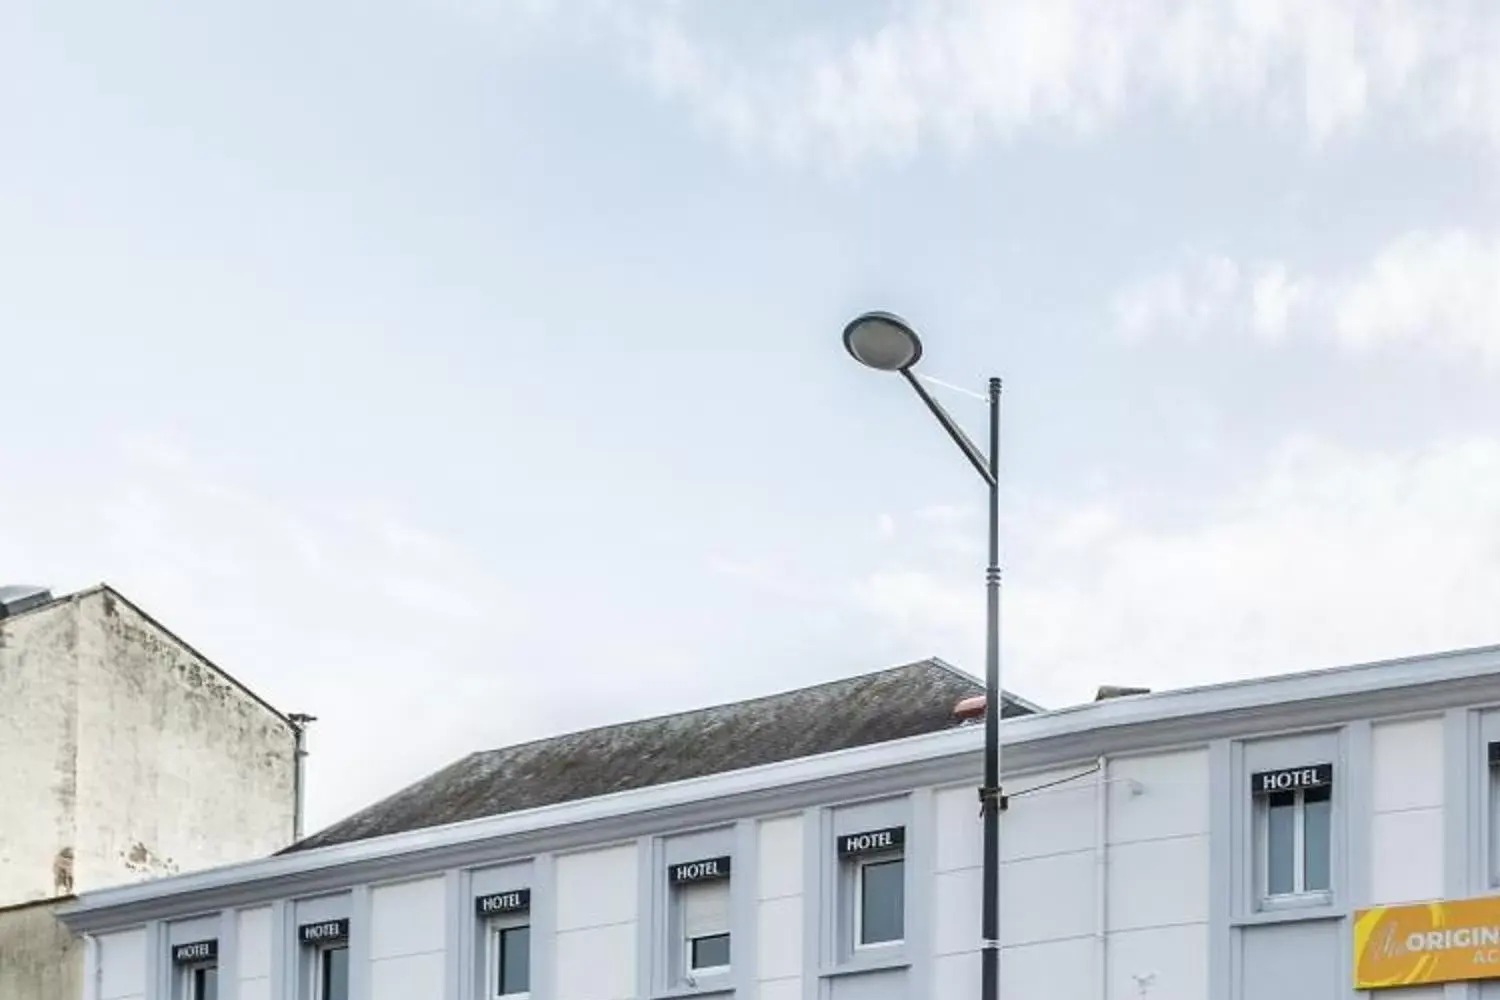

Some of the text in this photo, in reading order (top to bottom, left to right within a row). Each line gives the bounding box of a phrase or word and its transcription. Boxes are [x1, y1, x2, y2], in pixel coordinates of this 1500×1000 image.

[1263, 769, 1320, 789] HOTEL
[847, 831, 892, 850] HOTEL
[677, 862, 719, 880] HOTEL
[483, 893, 520, 910] HOTEL
[305, 925, 339, 940] HOTEL
[177, 944, 209, 958] HOTEL
